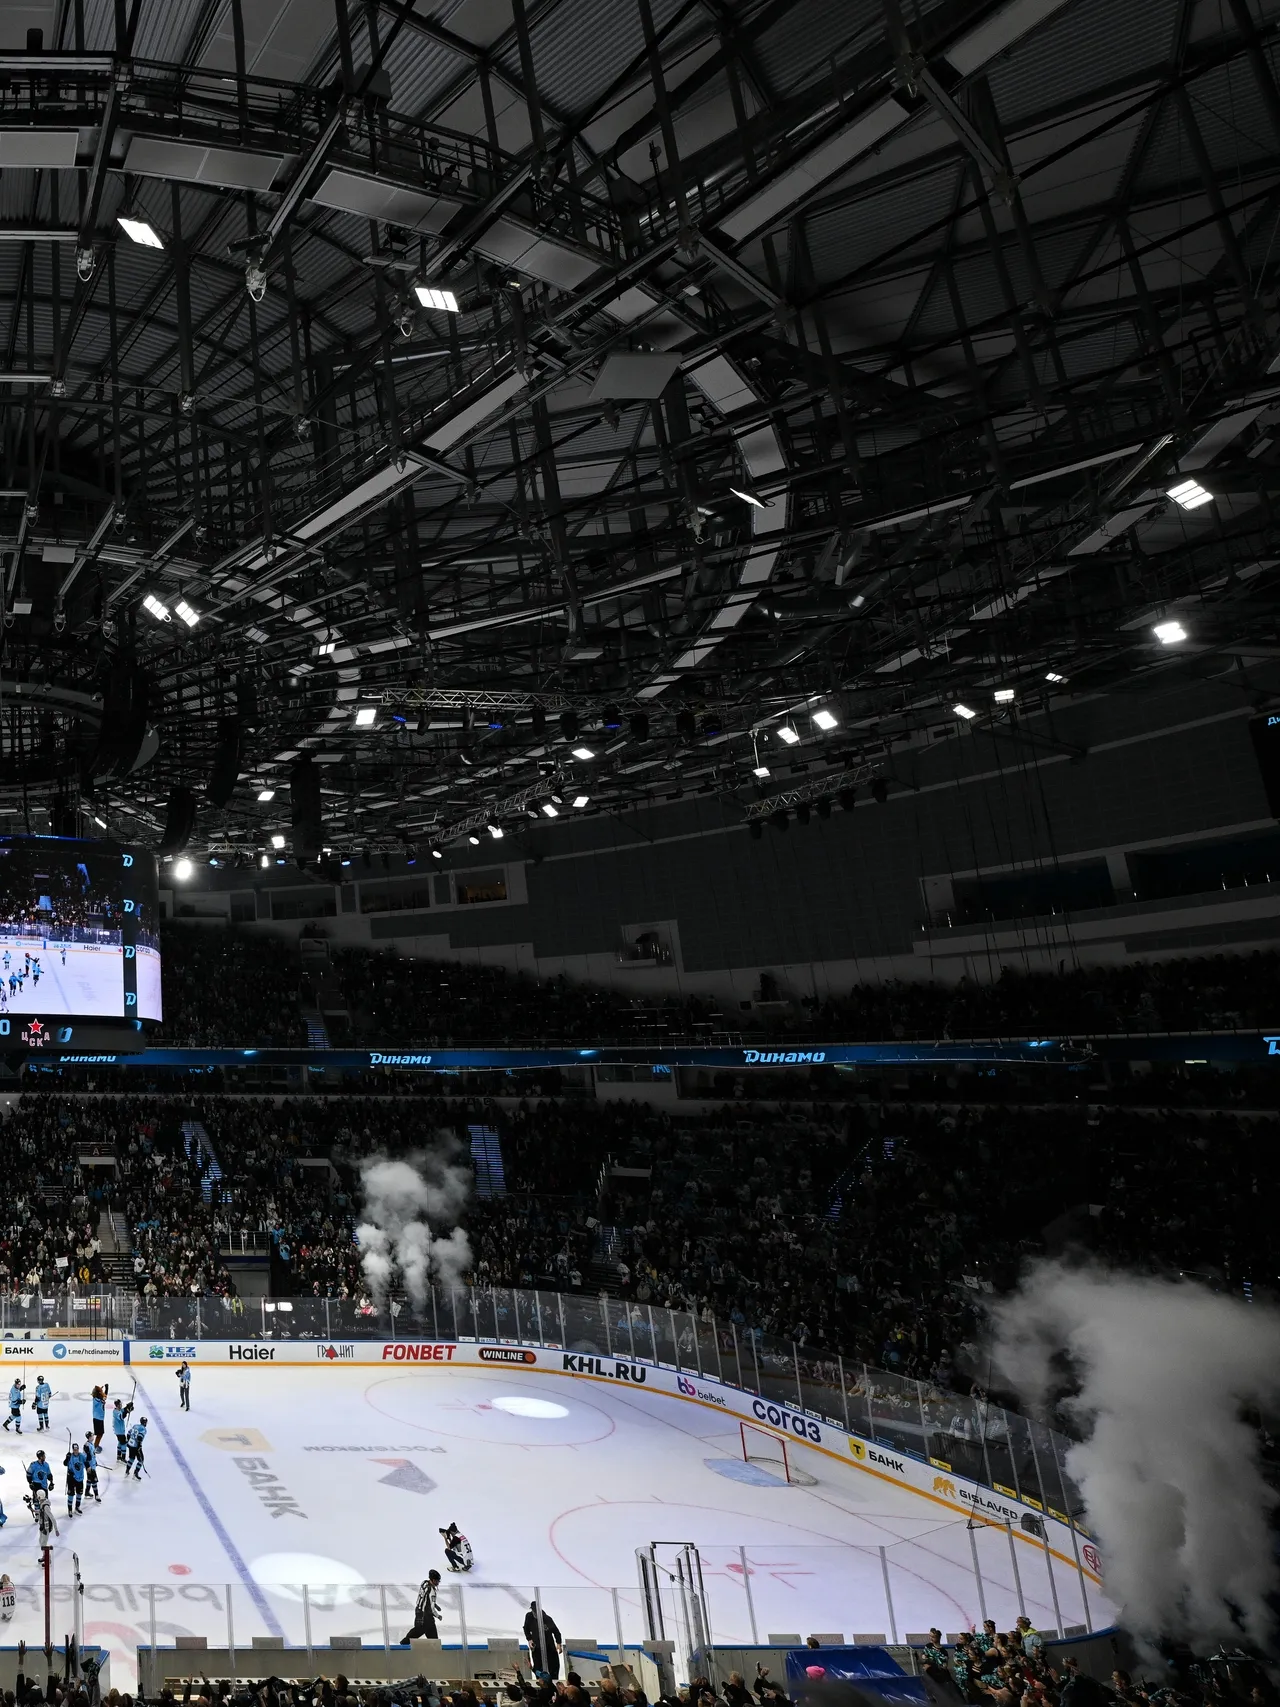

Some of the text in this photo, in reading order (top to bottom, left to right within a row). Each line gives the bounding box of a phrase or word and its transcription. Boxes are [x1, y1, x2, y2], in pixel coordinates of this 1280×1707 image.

[0, 1019, 11, 1036] 0
[21, 1032, 50, 1047] ЦСКА
[68, 1348, 120, 1356] t.me/hcdinamoby
[229, 1345, 275, 1360] Haier
[382, 1344, 456, 1361] FONBET
[482, 1350, 524, 1361] WINLINE
[562, 1354, 647, 1383] KHL.RU
[697, 1389, 727, 1407] belbet
[752, 1400, 822, 1443] согаз
[869, 1450, 905, 1474] БАНК
[232, 1457, 309, 1519] БАНК
[959, 1489, 1018, 1520] GISLAVED
[1, 1595, 15, 1607] 118
